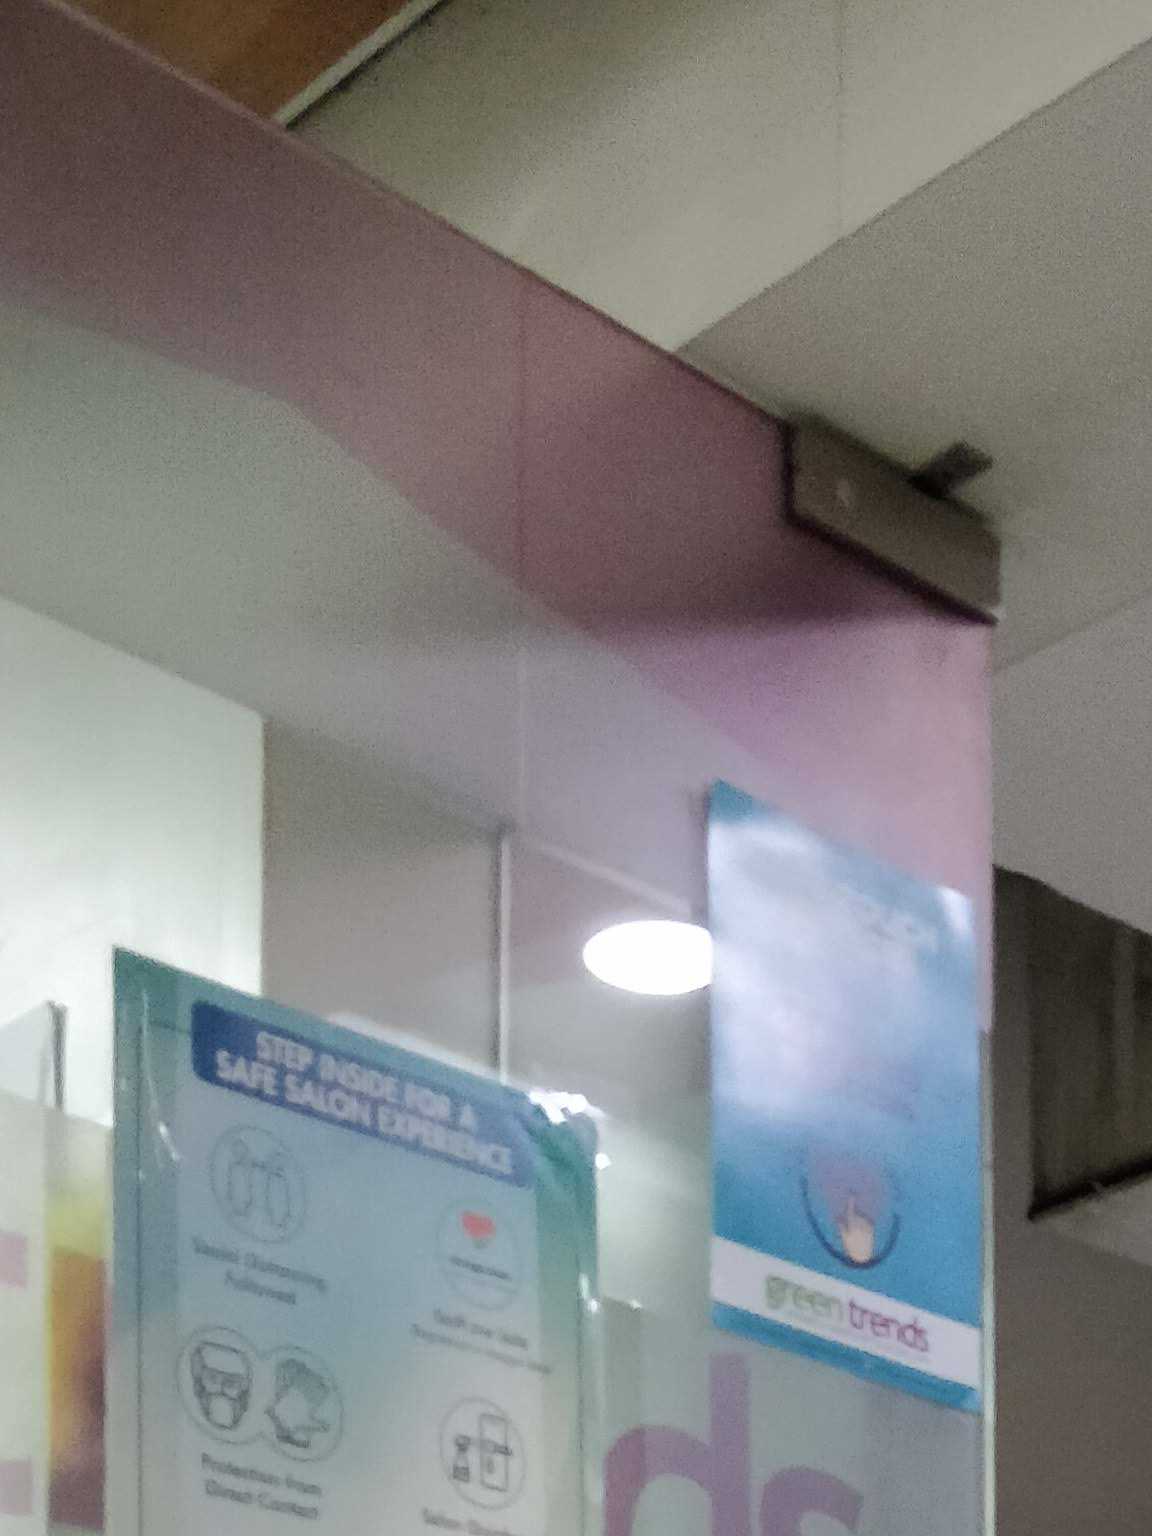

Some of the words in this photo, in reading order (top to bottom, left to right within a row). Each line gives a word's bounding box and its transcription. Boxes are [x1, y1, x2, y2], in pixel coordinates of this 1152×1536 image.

[215, 1048, 278, 1096] SAFE
[284, 1072, 374, 1128] SALON
[378, 1103, 514, 1174] EXPERIENCE
[256, 1031, 313, 1071] STEP
[318, 1053, 398, 1101] INSIDE
[404, 1083, 450, 1120] FOR
[459, 1103, 476, 1133] A
[765, 1274, 844, 1322] green
[848, 1298, 930, 1353] trends
